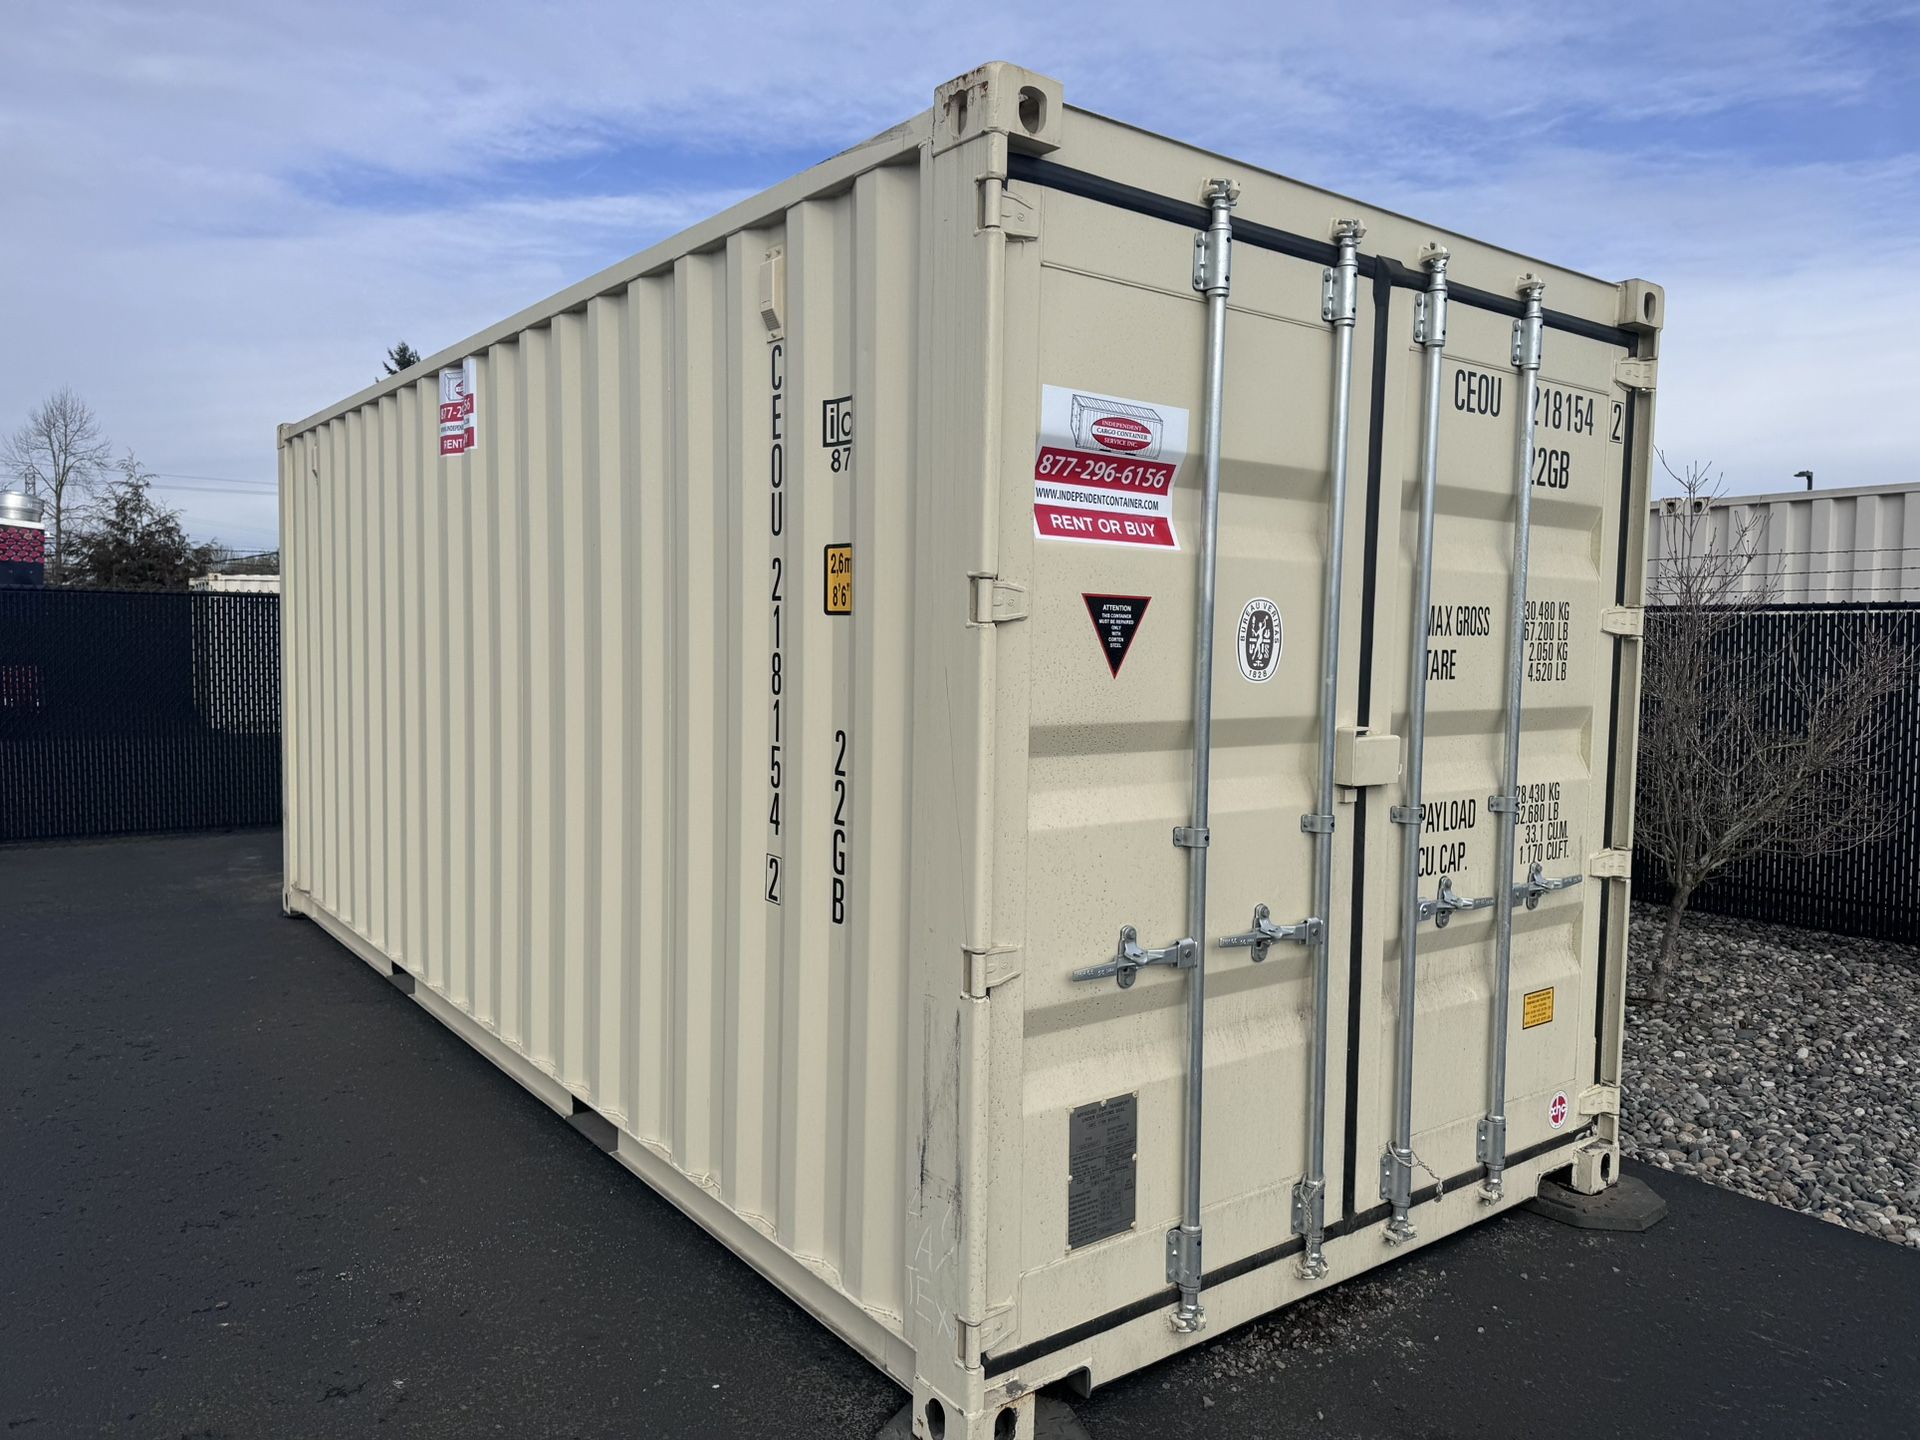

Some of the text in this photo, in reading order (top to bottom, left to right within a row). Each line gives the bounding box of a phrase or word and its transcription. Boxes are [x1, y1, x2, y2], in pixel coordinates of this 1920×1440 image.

[1454, 369, 1502, 417] CEOU
[1611, 403, 1622, 441] 2
[1102, 420, 1142, 431] INDEPENDENT
[1116, 430, 1148, 440] CONTAINER
[771, 344, 783, 536] CEOU
[1104, 437, 1126, 446] SERVICE
[831, 447, 851, 473] 87
[1039, 454, 1167, 488] 877-296-6156
[1035, 487, 1159, 511] WWW.INDEPENDENTCONTAINER.COM
[1050, 513, 1155, 537] RENT OR BUY
[1456, 605, 1490, 636] GROSS
[1559, 601, 1570, 620] KG
[1524, 622, 1569, 641] 67.200 LB
[1529, 642, 1568, 661] 2.050 KG
[1249, 669, 1267, 679] 1828
[1528, 662, 1567, 682] 4.520 LB
[770, 557, 782, 836] 218154
[1549, 782, 1560, 801] KG
[1548, 801, 1559, 821] LB
[832, 730, 846, 925] 22GB
[1525, 823, 1543, 844] 33.1
[1520, 843, 1543, 865] 1.170
